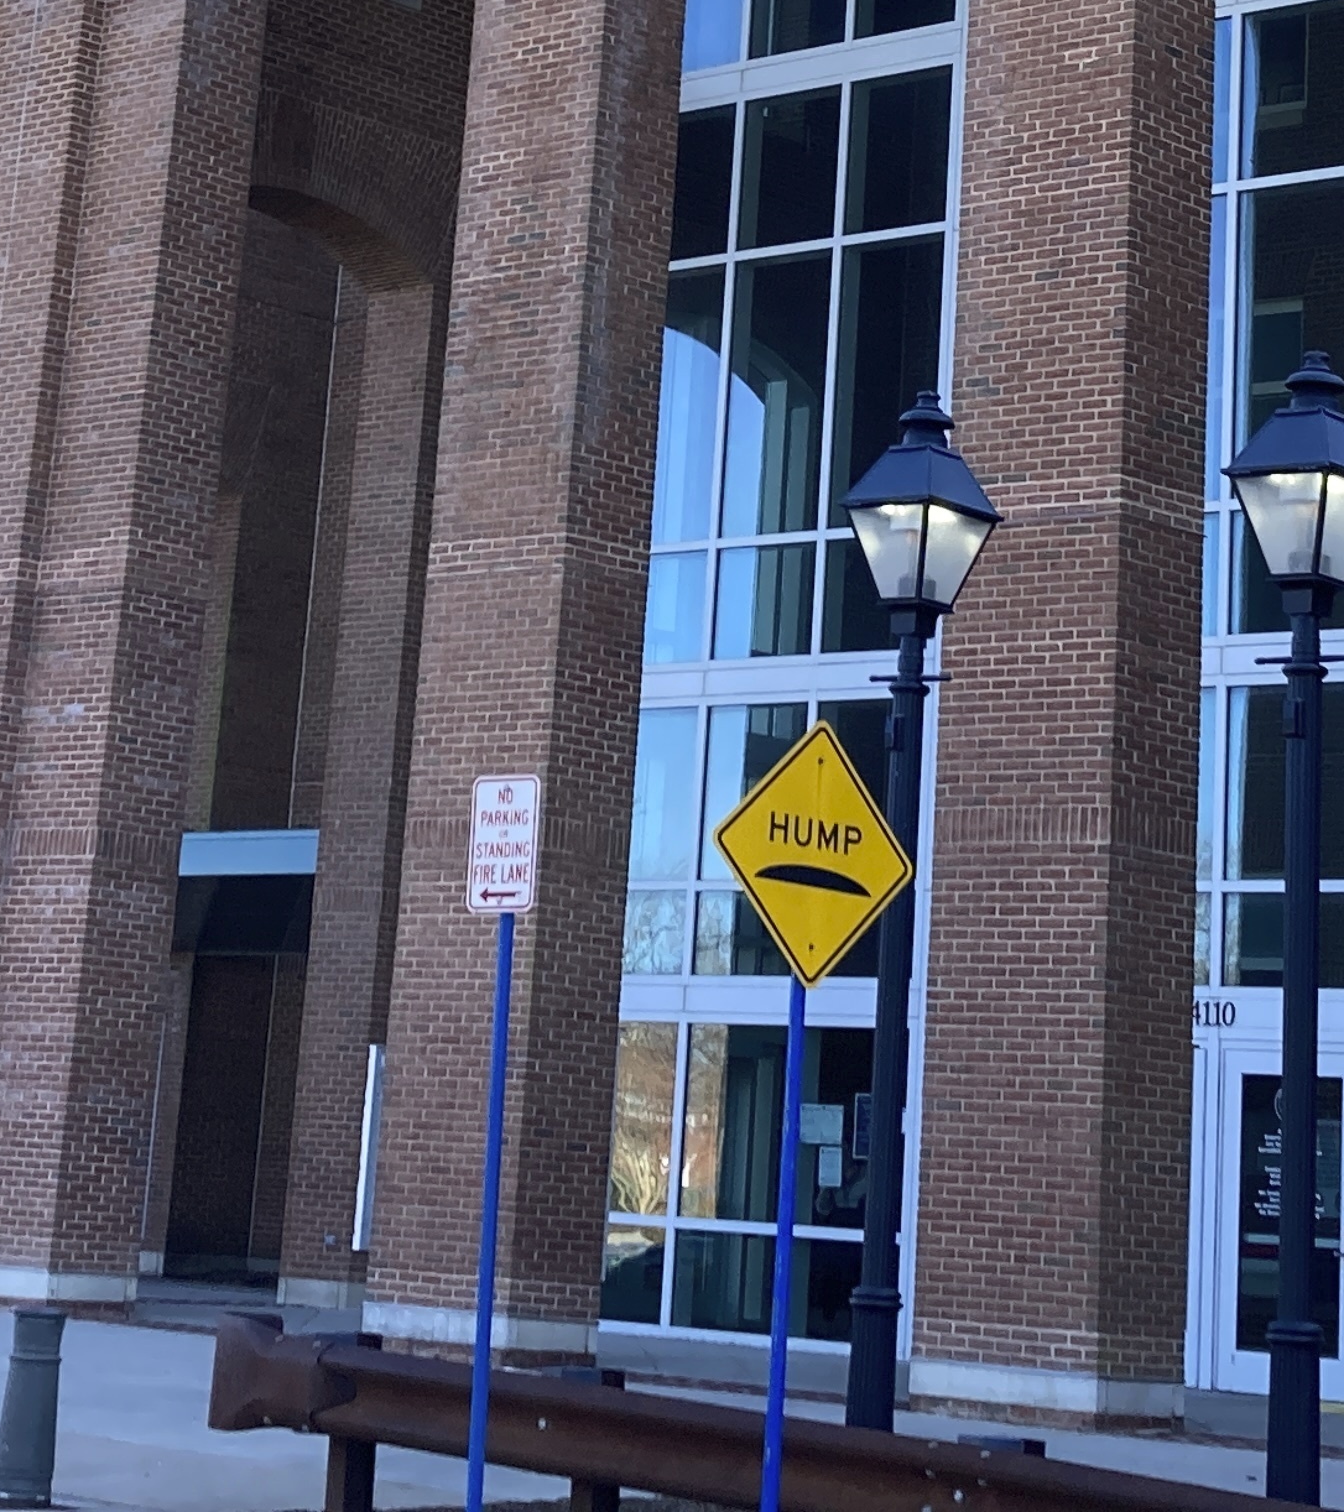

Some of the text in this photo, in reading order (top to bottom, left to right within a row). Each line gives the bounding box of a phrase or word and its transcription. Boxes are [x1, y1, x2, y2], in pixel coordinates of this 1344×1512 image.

[499, 788, 513, 804] NO
[481, 809, 529, 826] PARKING
[769, 811, 862, 855] HUMP
[476, 842, 530, 859] STANDING
[474, 864, 529, 884] FIRE LANE
